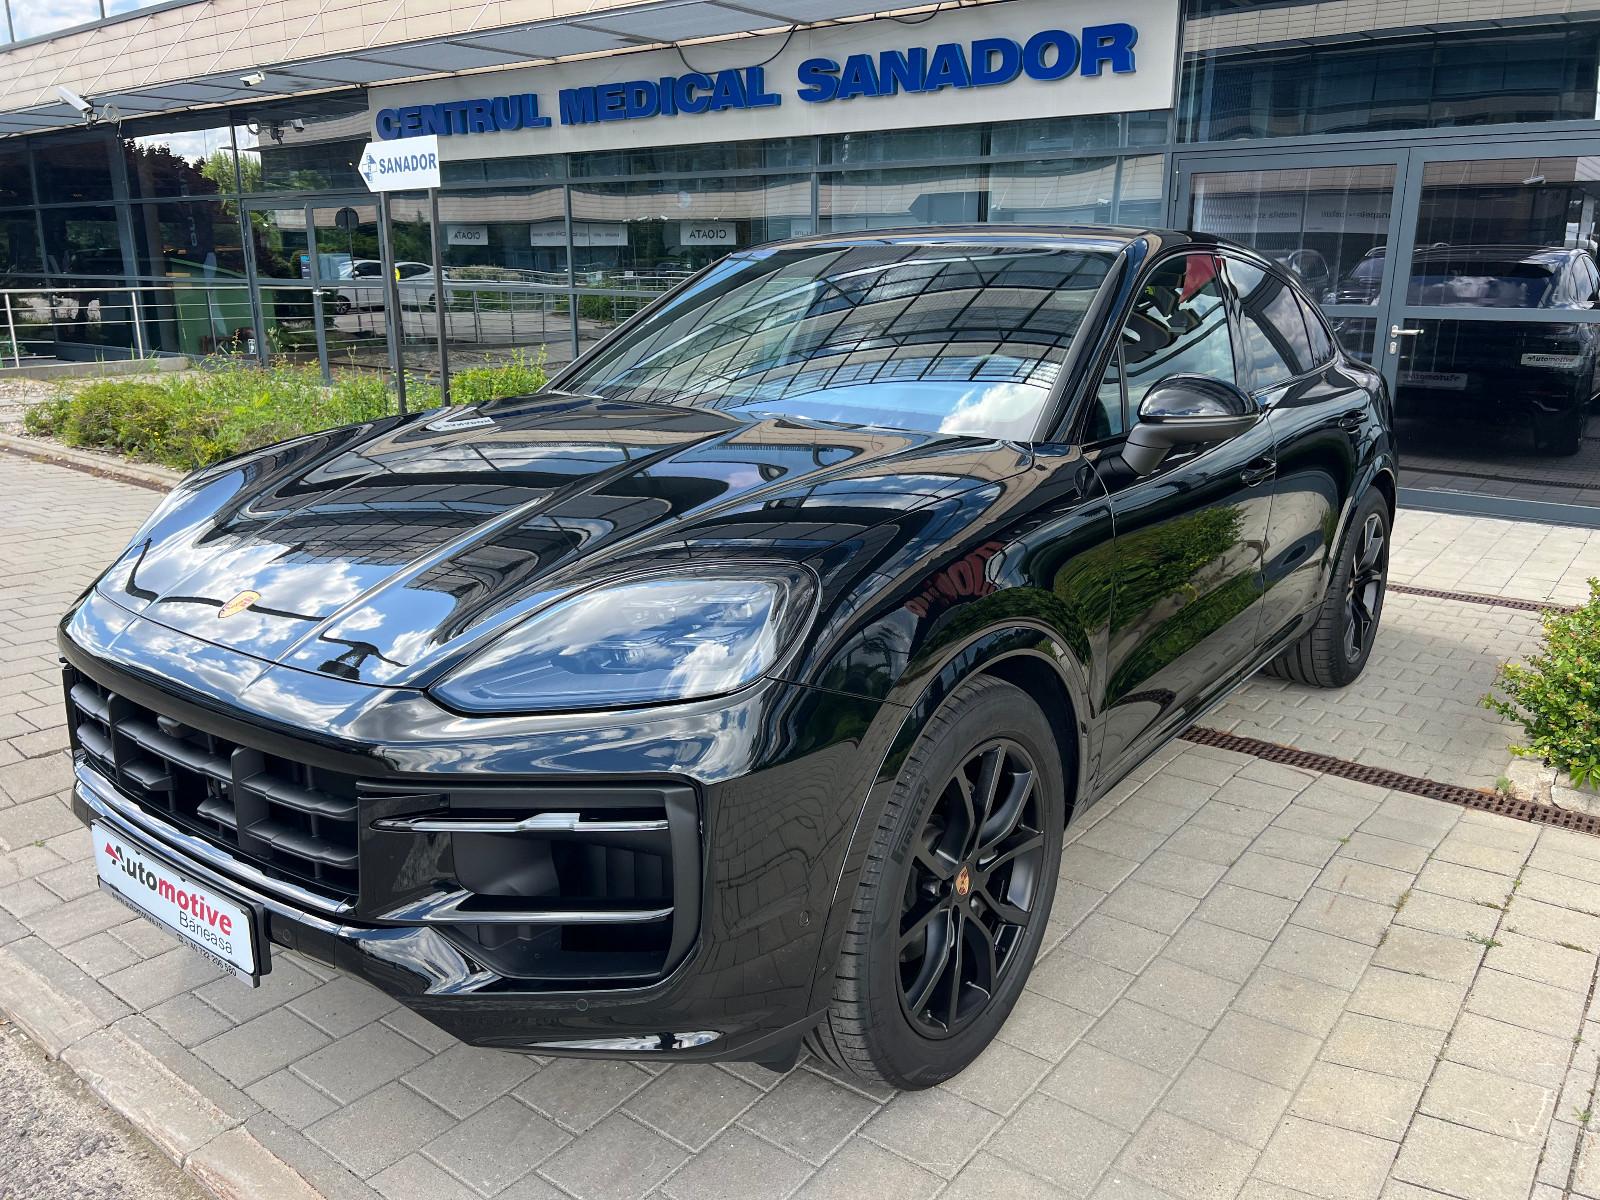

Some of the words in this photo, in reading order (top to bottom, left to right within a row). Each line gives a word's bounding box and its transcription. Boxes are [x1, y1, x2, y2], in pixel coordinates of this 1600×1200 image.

[376, 93, 552, 140] CENTRUL
[559, 67, 782, 126] MEDICAL
[797, 23, 1139, 103] SANADOR
[379, 153, 437, 175] SANADOR
[105, 842, 233, 936] Automotive
[179, 910, 233, 955] Băneasa
